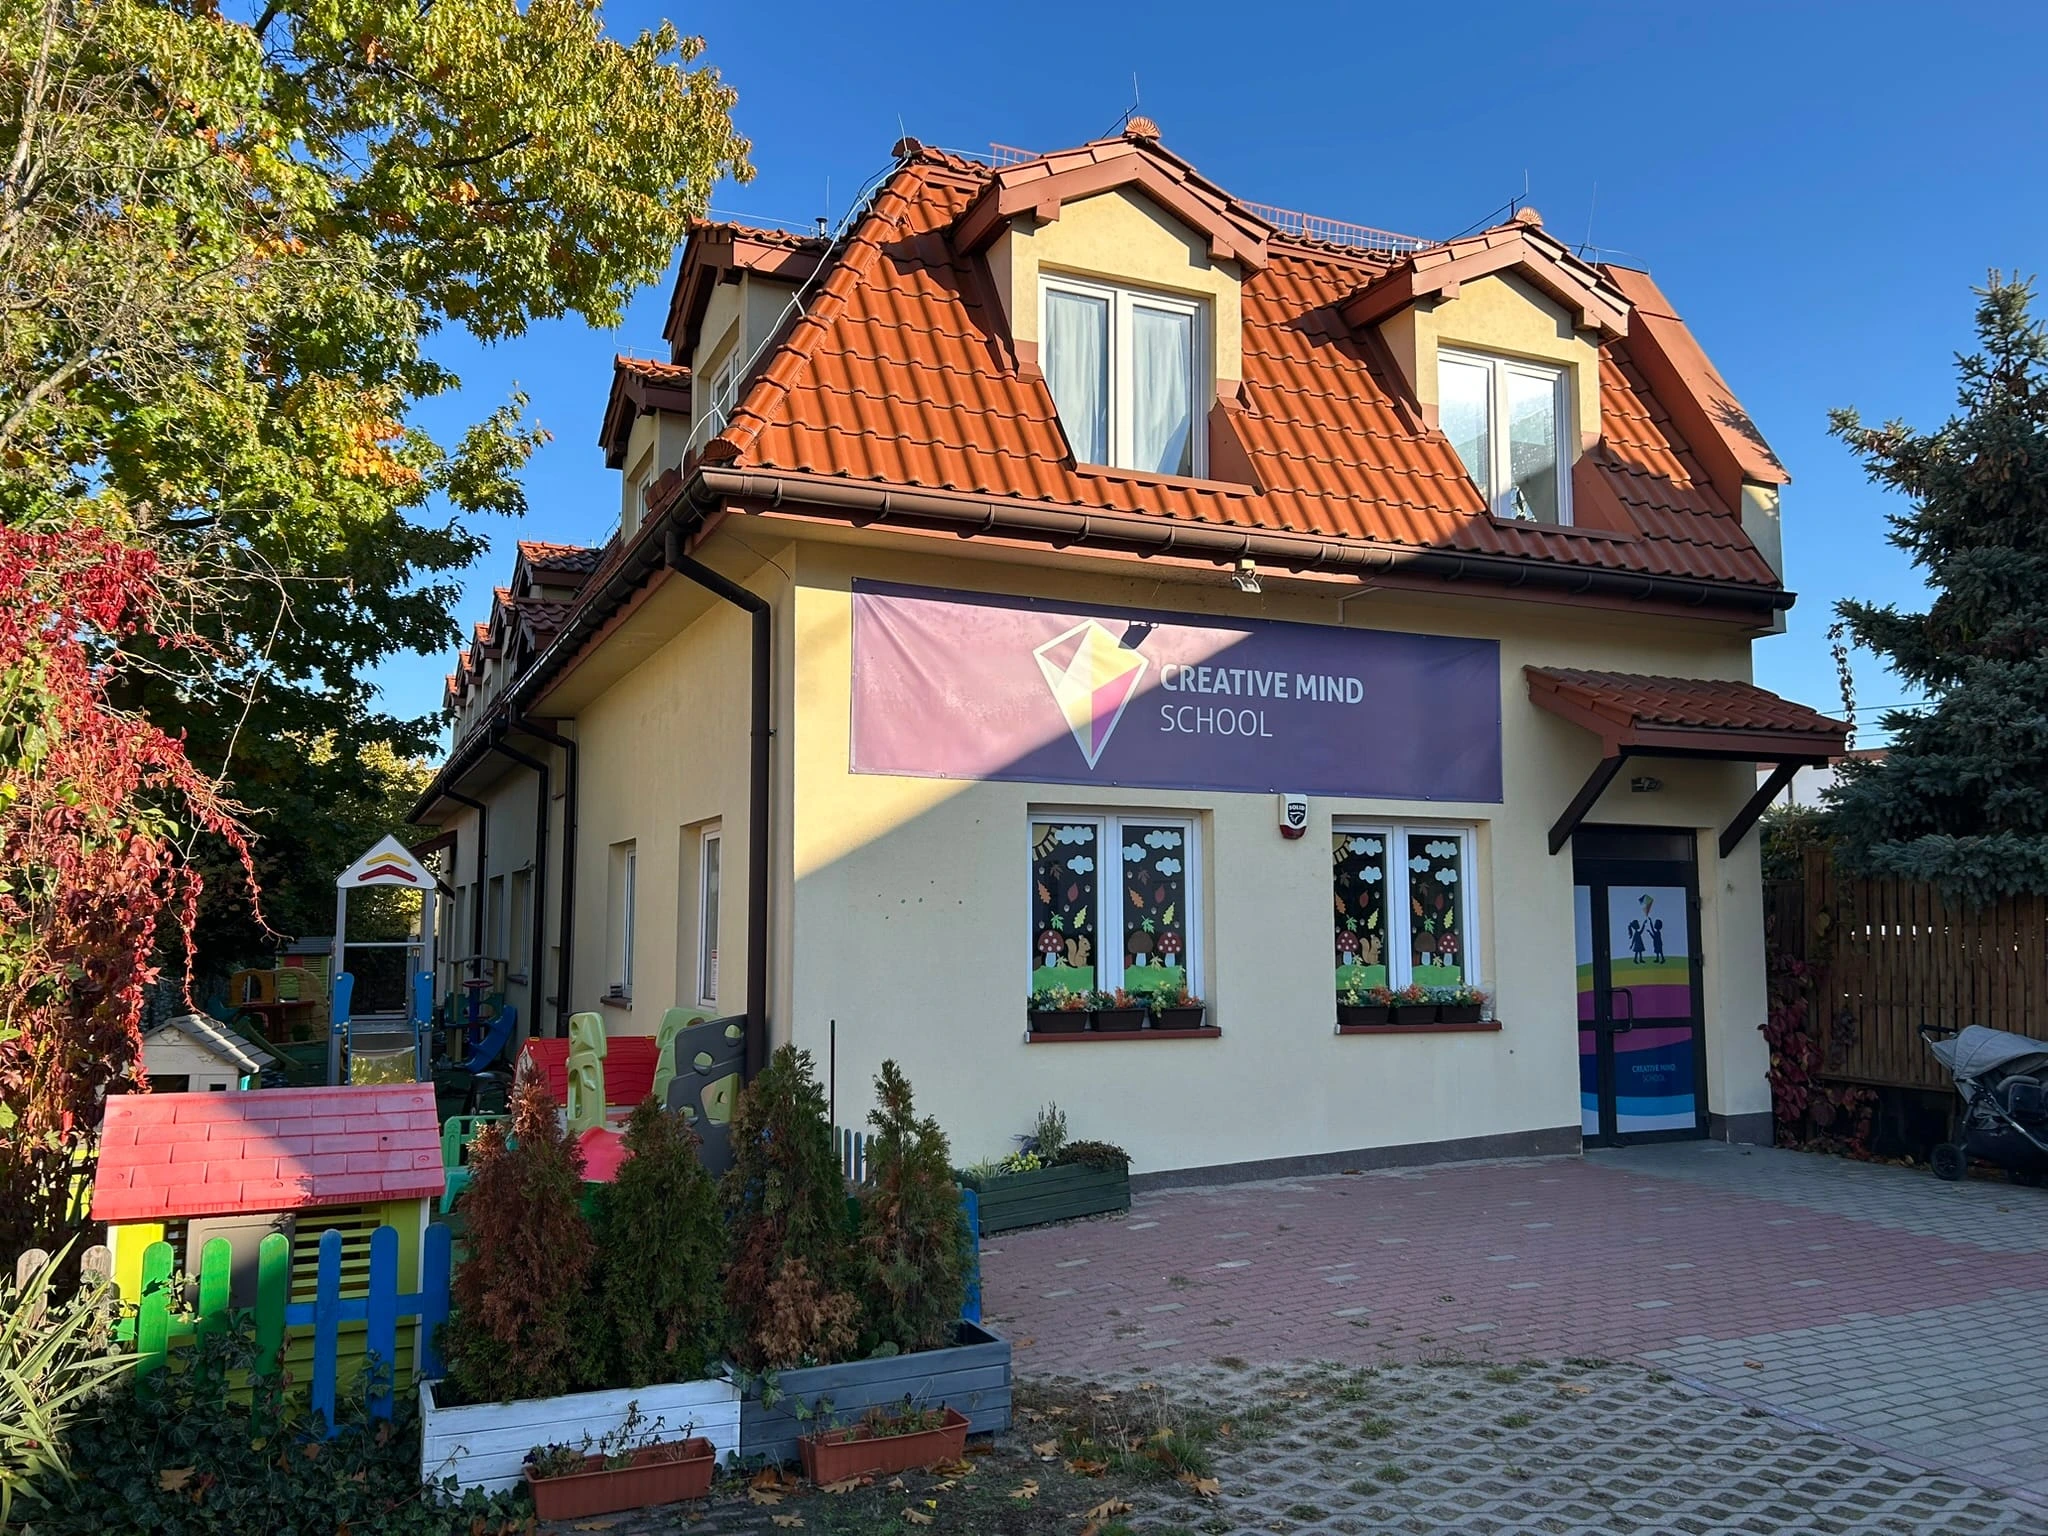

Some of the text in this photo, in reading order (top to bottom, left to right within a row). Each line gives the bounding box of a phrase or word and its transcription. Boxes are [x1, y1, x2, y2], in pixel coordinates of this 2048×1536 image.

[1160, 664, 1364, 704] CREATIVE MIND
[1160, 704, 1273, 737] SCHOOL
